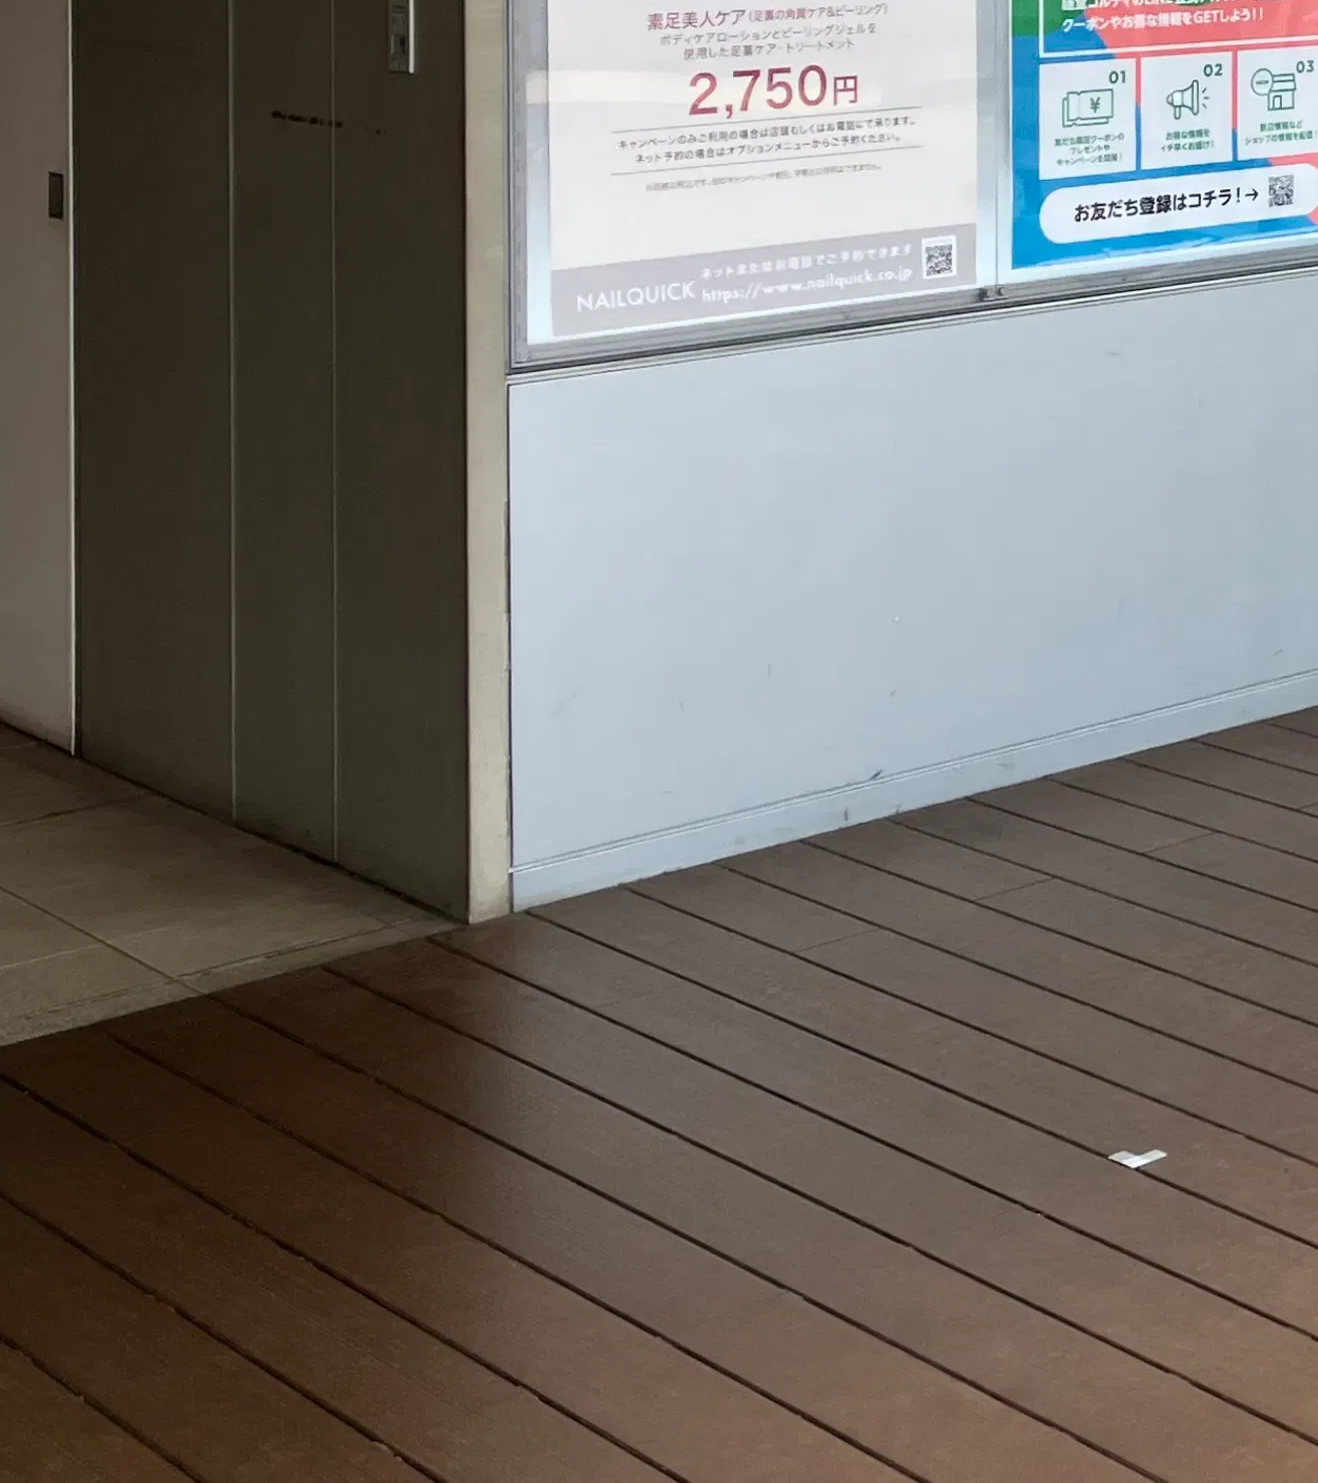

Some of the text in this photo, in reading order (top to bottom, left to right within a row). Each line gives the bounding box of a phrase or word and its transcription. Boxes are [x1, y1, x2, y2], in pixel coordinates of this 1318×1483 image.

[1203, 63, 1224, 78] 02
[1295, 60, 1315, 75] 03
[1108, 70, 1127, 85] 01
[688, 64, 859, 119] 2,750円
[576, 280, 697, 313] NAILQUICK
